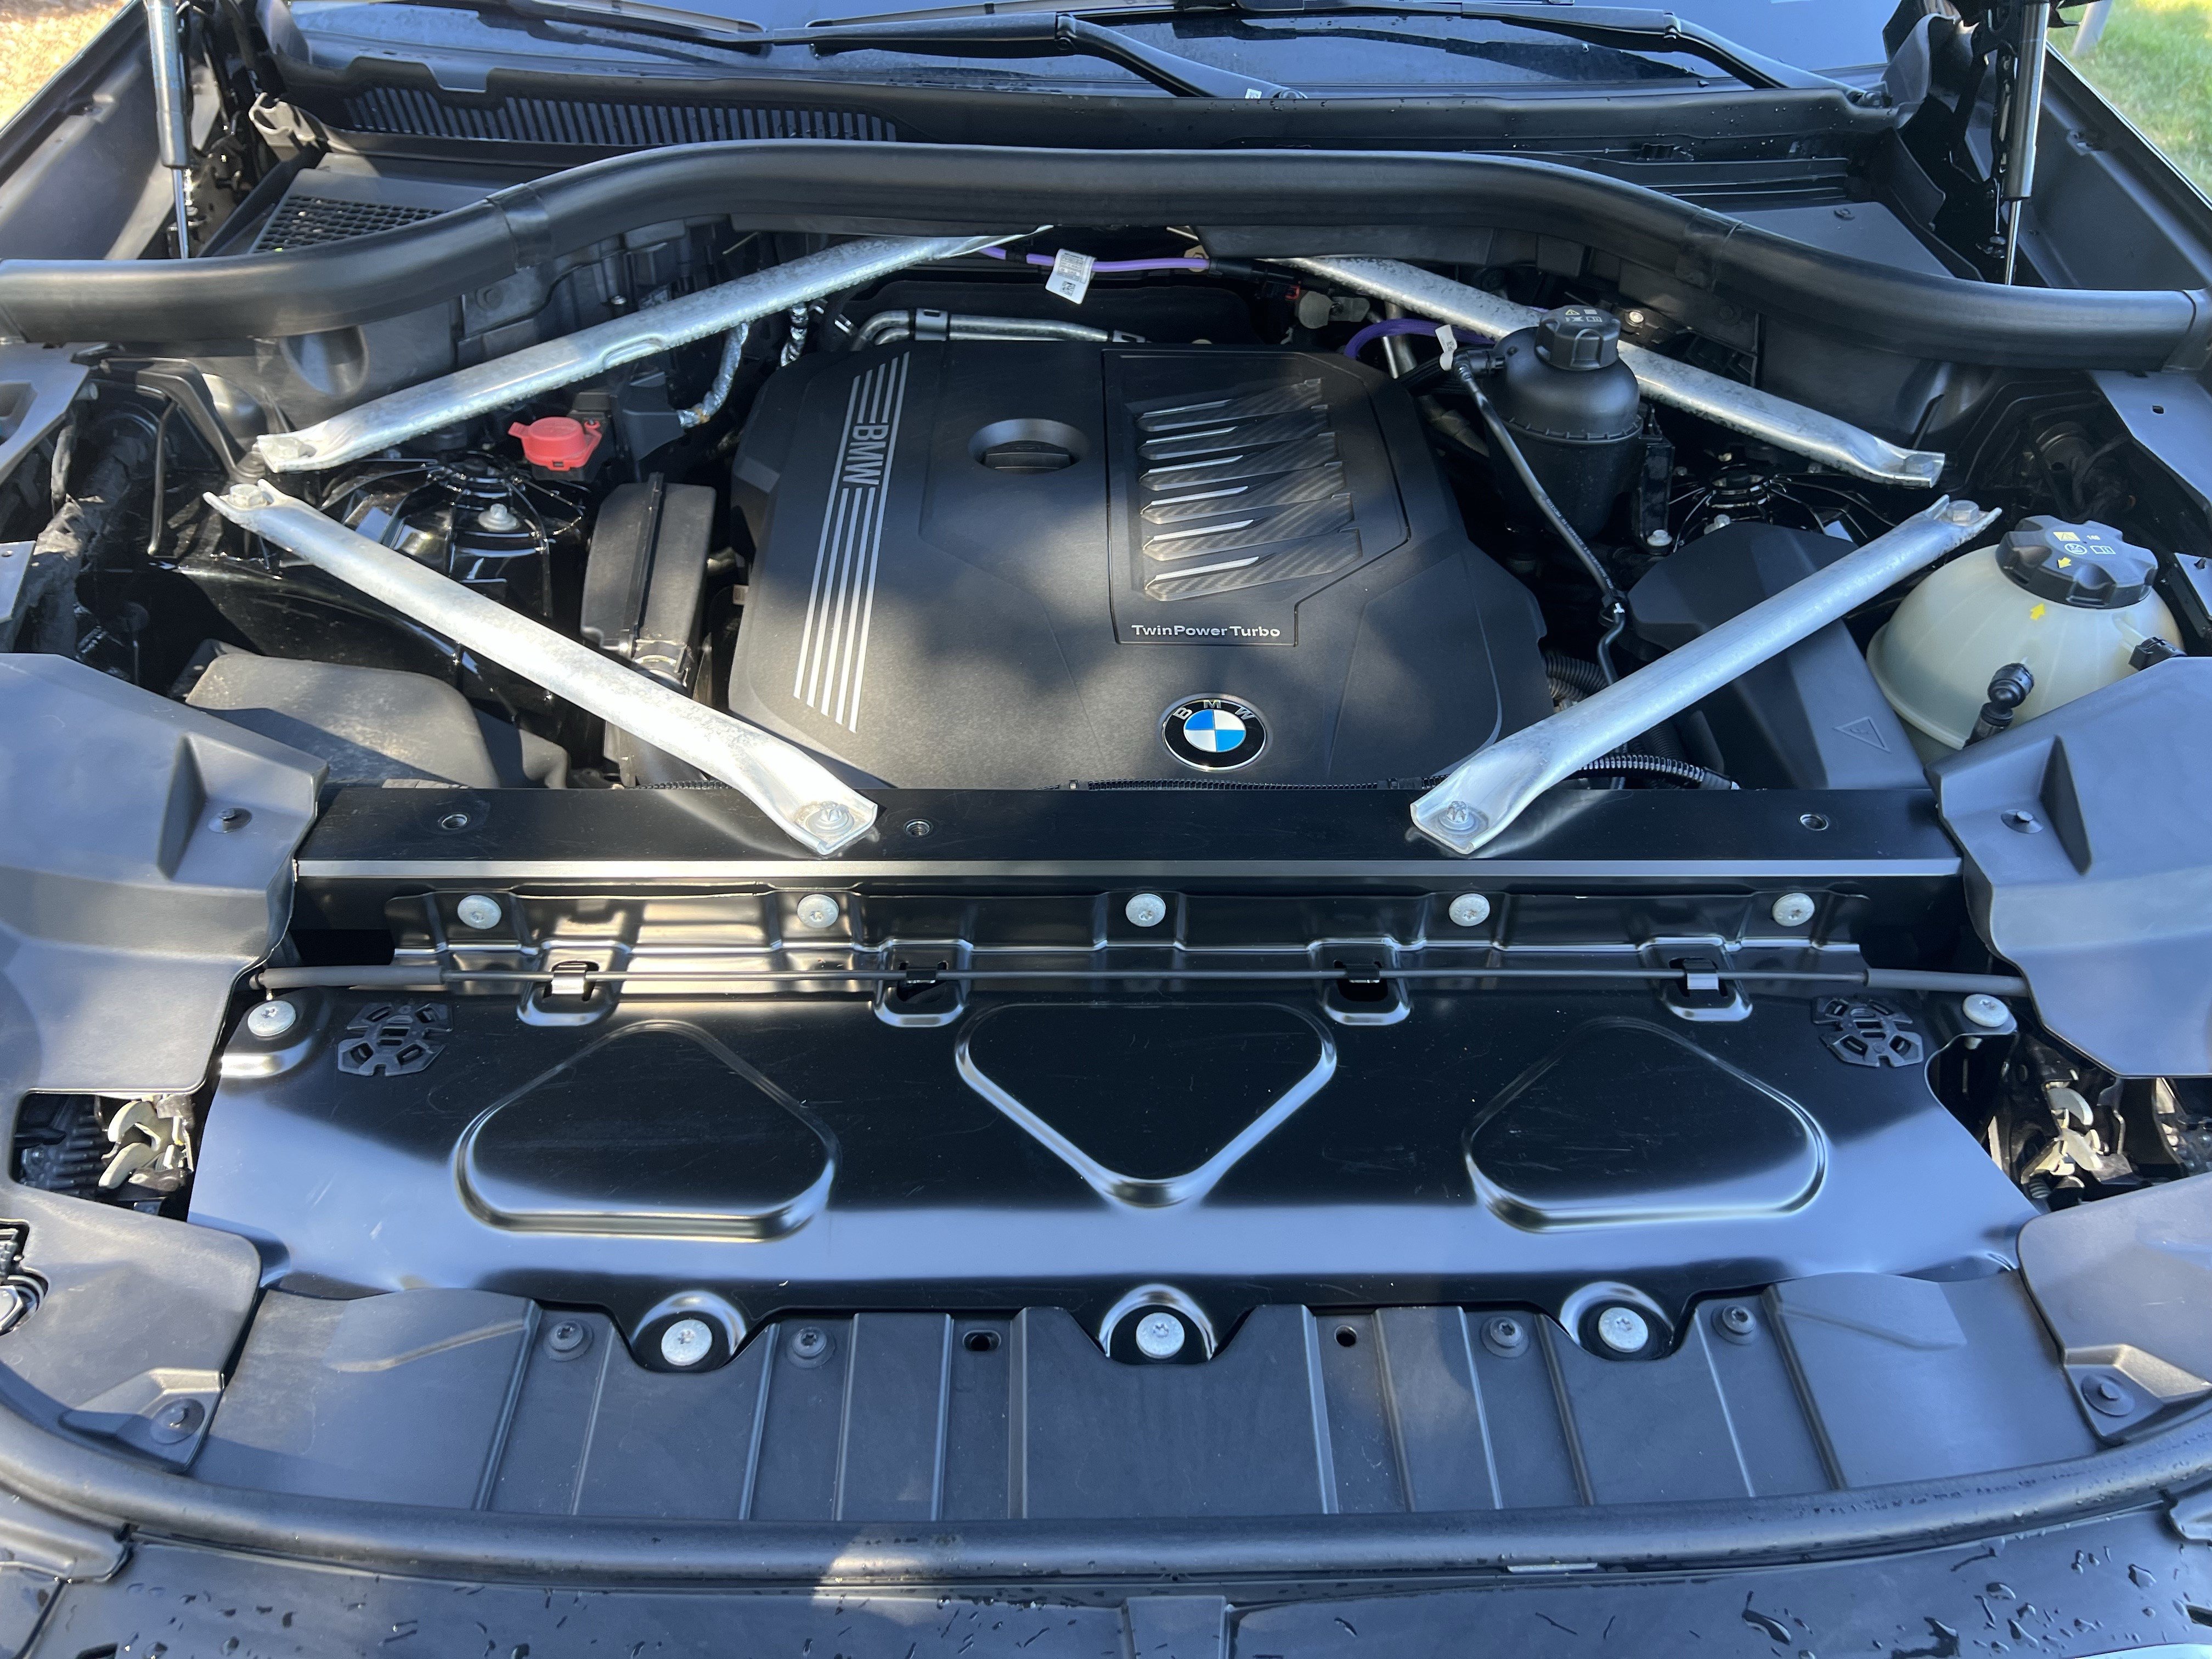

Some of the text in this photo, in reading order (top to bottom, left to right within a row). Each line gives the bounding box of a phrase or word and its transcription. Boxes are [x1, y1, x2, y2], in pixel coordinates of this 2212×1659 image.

[843, 425, 889, 485] BMW
[1131, 624, 1280, 637] TwinPower Turbo
[1172, 699, 1256, 720] BMW
